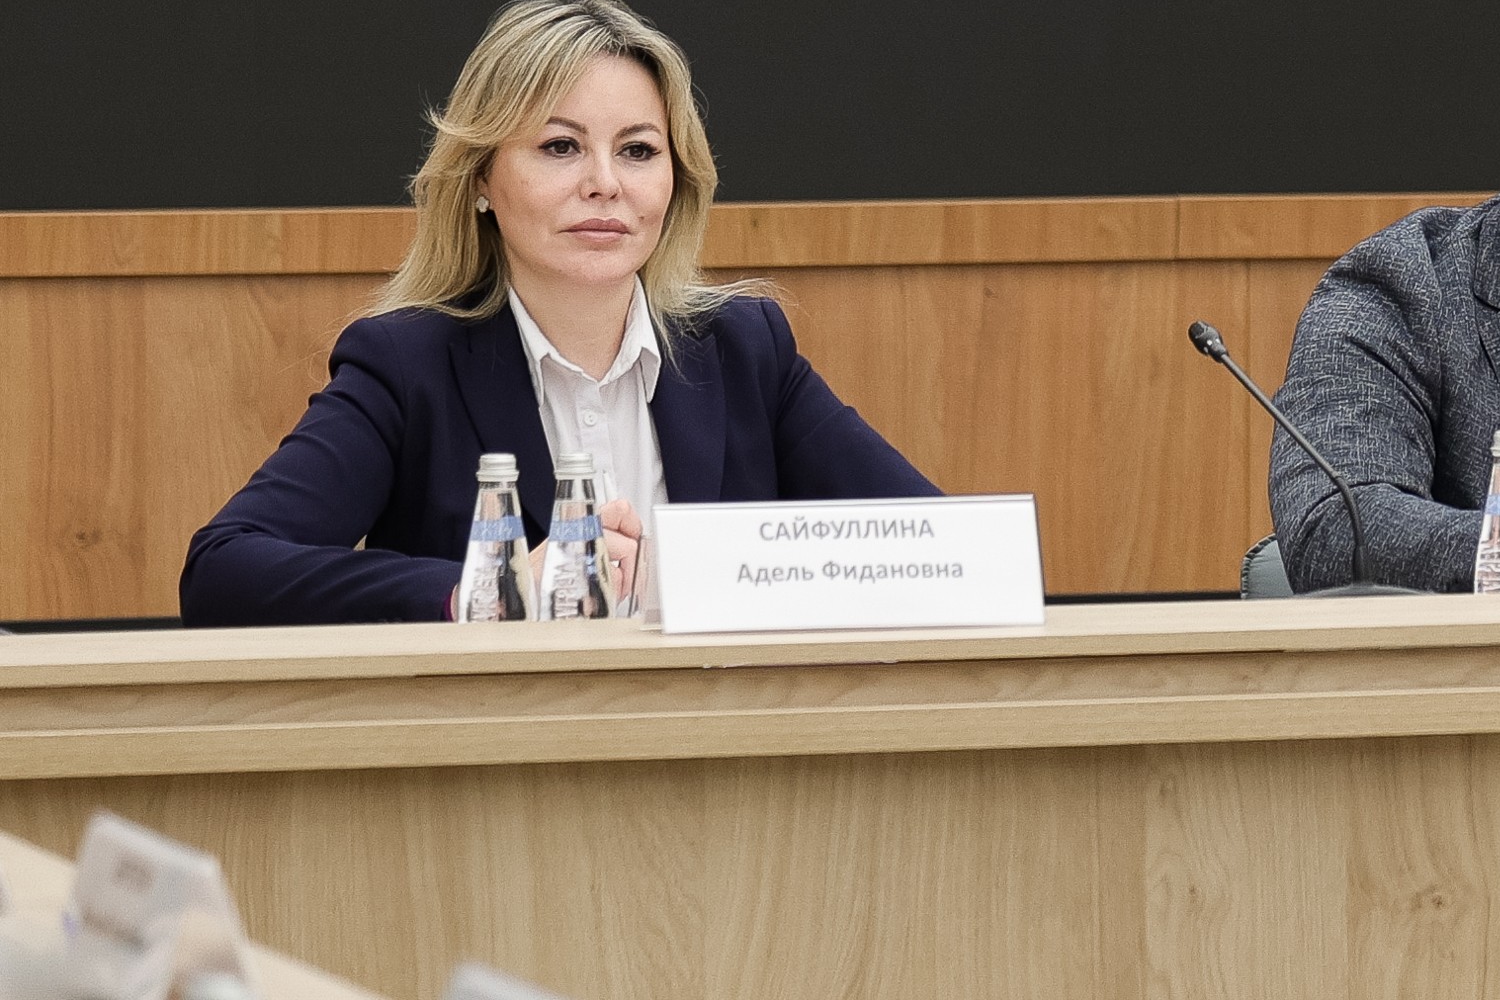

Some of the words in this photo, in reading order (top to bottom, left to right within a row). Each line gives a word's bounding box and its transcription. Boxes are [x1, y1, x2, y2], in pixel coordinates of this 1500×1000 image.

[758, 515, 936, 542] САЙФУЛЛИНА
[737, 562, 815, 587] Адель
[821, 560, 965, 584] Фидановна
